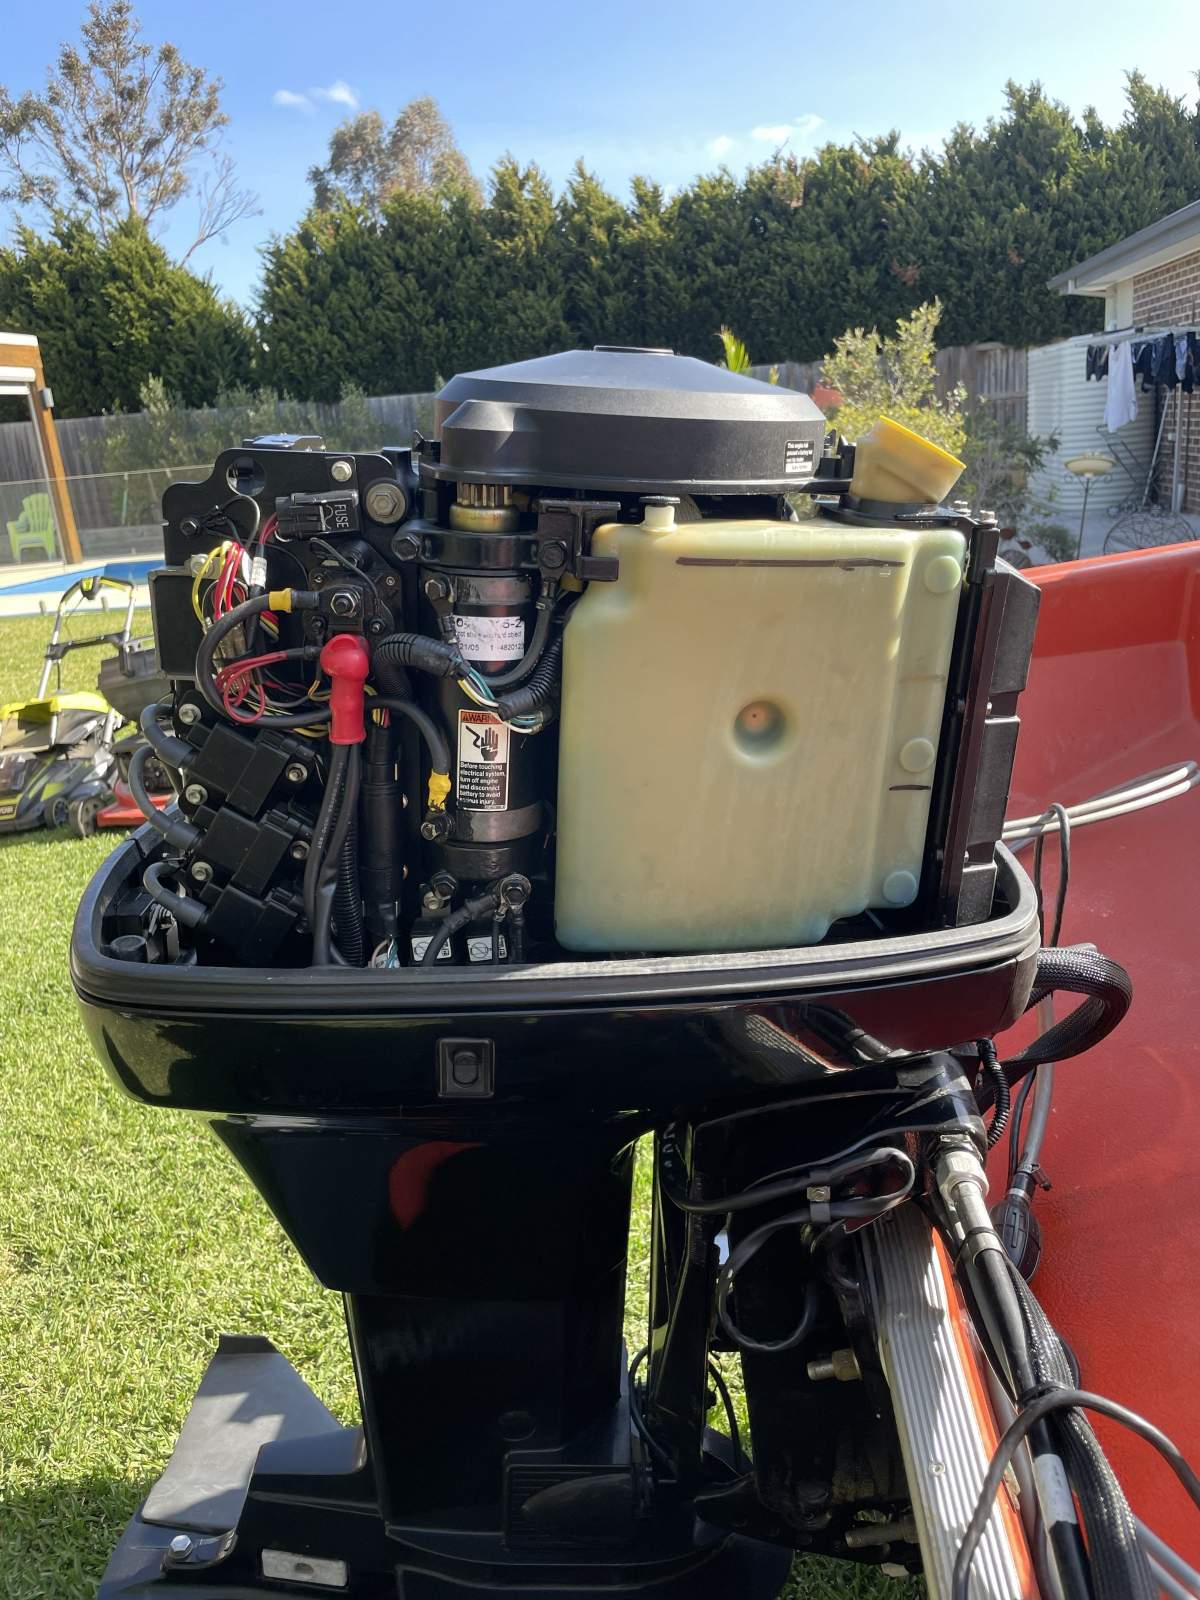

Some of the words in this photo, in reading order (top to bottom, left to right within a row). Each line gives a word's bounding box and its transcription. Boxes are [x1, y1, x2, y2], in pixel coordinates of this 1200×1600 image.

[334, 504, 350, 528] FUSE
[460, 761, 478, 769] Before
[478, 763, 503, 771] touching
[460, 790, 478, 798] battery
